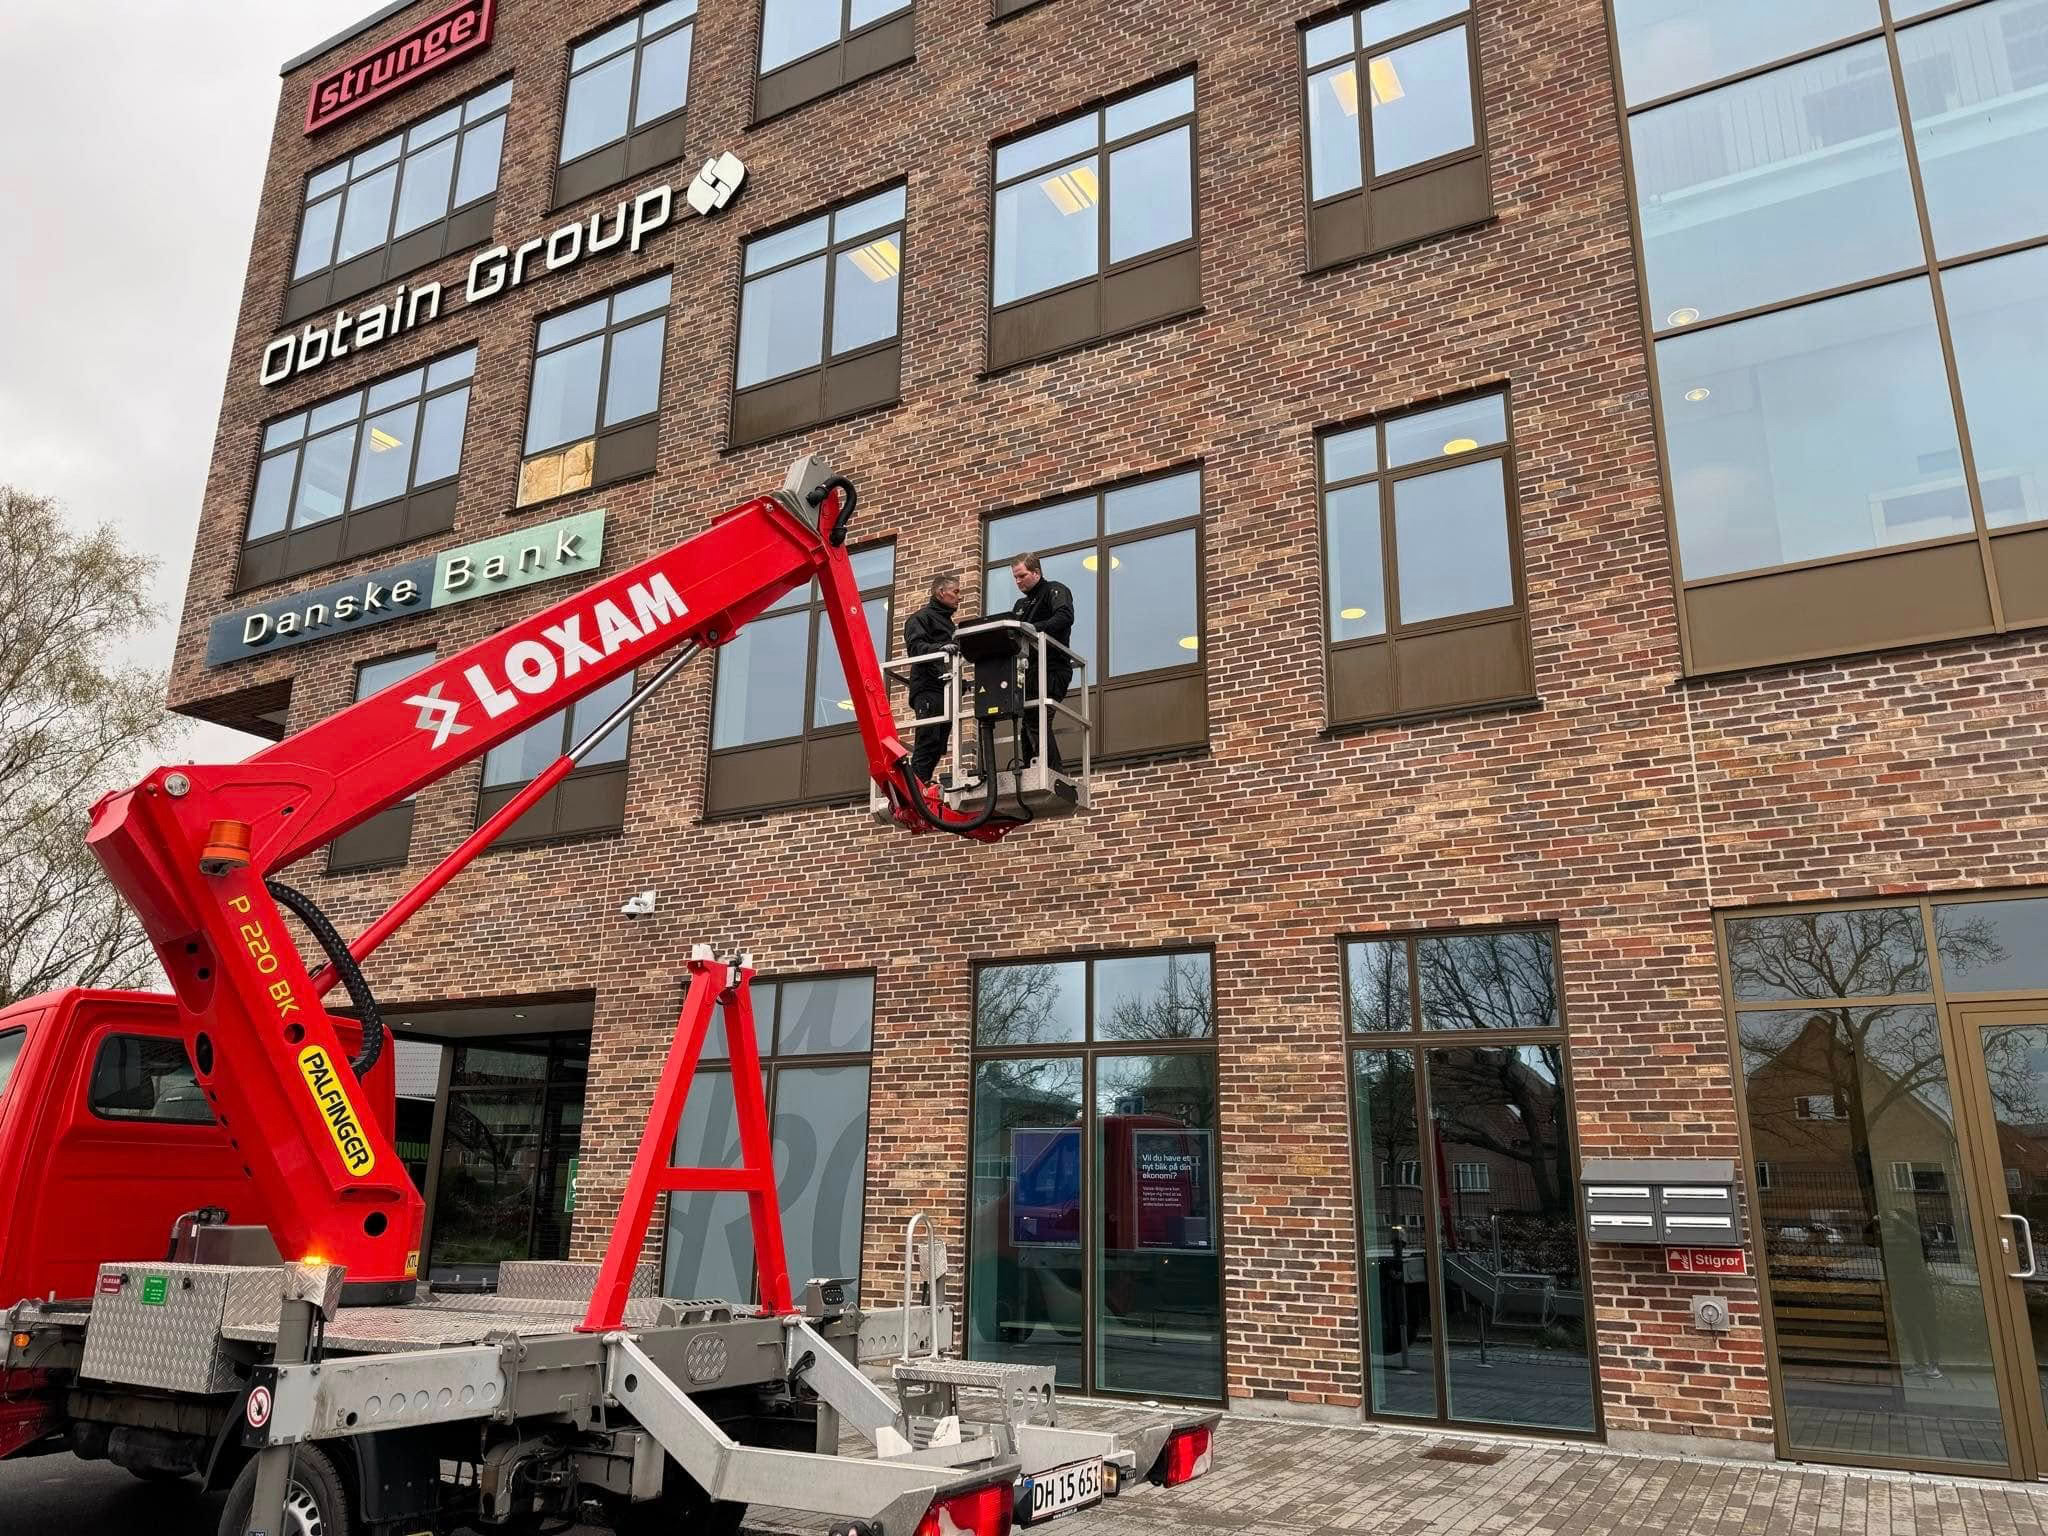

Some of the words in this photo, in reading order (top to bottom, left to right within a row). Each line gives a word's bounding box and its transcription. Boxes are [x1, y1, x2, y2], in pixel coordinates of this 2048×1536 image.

[318, 10, 476, 114] strunge
[260, 280, 442, 386] Obtain
[464, 183, 672, 303] Group
[241, 576, 418, 646] Danske
[443, 527, 583, 594] Bank
[463, 571, 690, 720] LOXAM
[227, 895, 251, 914] P
[240, 921, 278, 974] 220
[268, 979, 301, 1019] BK
[302, 1051, 371, 1171] PALFINGER
[1695, 1254, 1740, 1268] Stigrør
[1034, 1479, 1055, 1511] DH
[1059, 1472, 1075, 1504] 15
[1078, 1465, 1100, 1497] 651
